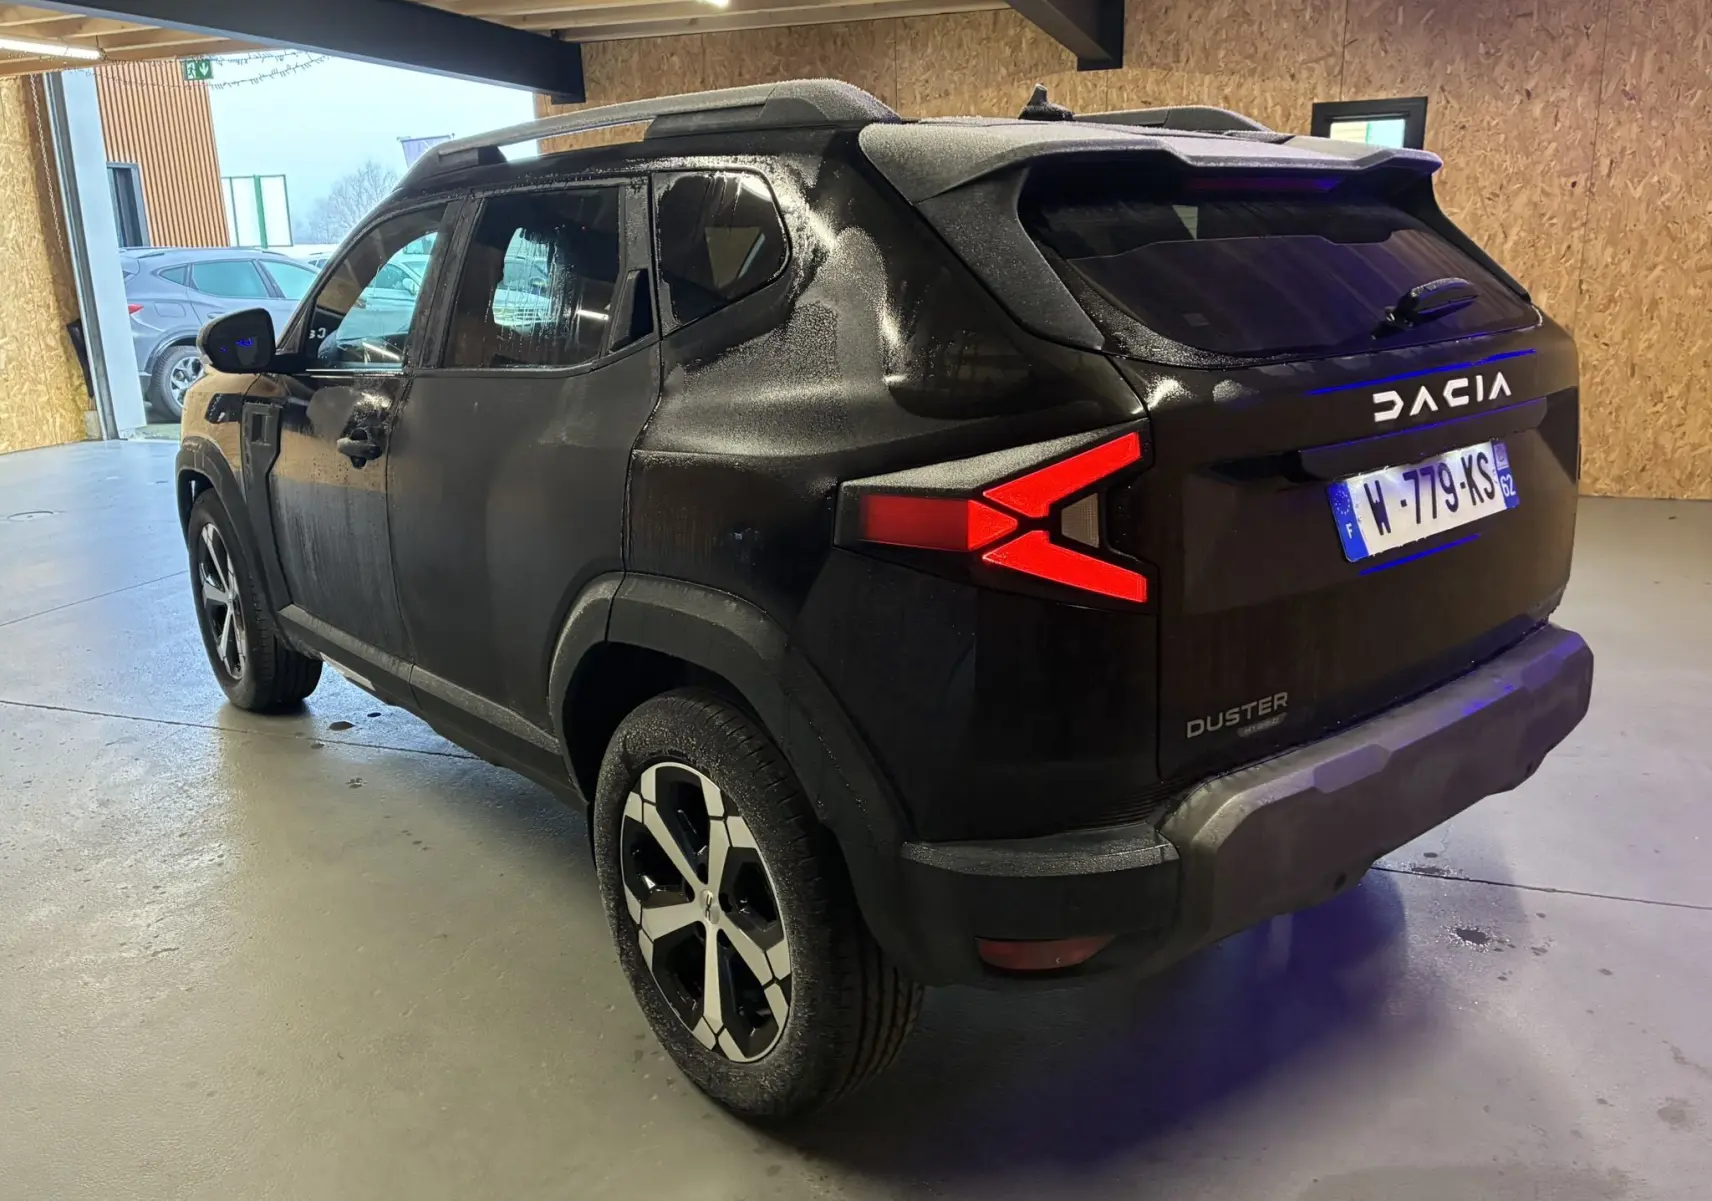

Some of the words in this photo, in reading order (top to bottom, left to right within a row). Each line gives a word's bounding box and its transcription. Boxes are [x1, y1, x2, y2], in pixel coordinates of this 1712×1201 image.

[1373, 372, 1512, 422] DACIA
[1500, 474, 1517, 497] 62
[1345, 522, 1354, 539] F
[1186, 691, 1288, 738] DUSTER
